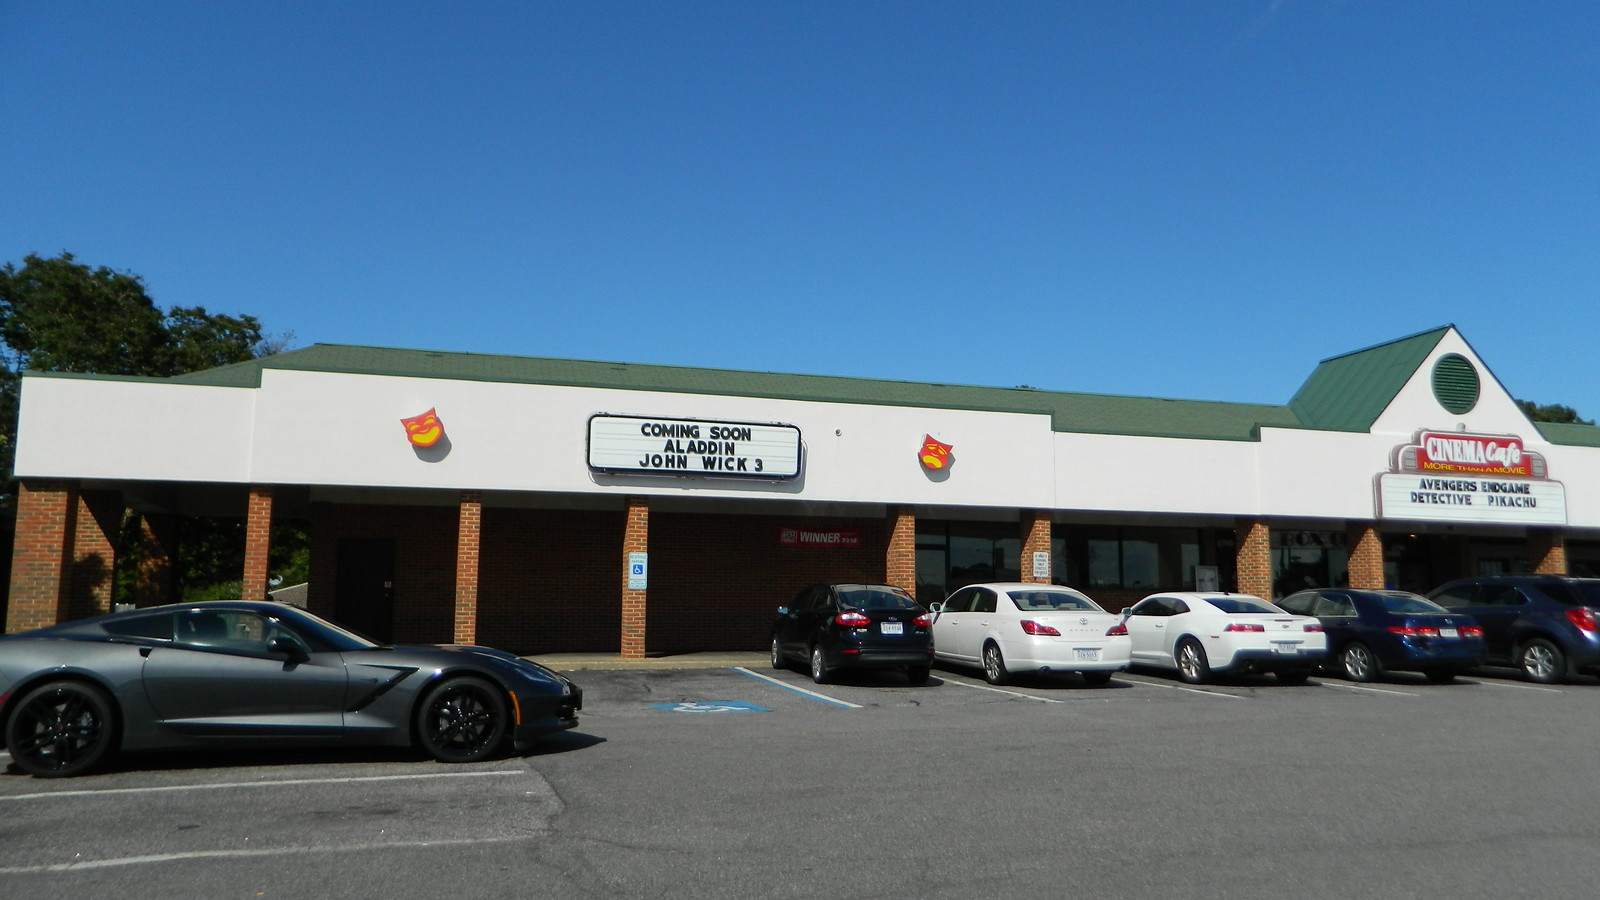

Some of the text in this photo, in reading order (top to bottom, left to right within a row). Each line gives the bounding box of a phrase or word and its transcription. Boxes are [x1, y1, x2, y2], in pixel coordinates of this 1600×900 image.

[640, 422, 751, 441] COMING SOON
[663, 439, 735, 455] ALADDIN
[1426, 437, 1487, 464] CINEMA
[639, 453, 763, 472] JOHN WICK 3
[1423, 461, 1455, 471] MORE
[1493, 466, 1526, 475] MOVIE
[1419, 478, 1530, 495] AVENGERS ENDGAME
[1410, 491, 1537, 508] DETECTIVE PIKACHU
[800, 531, 840, 543] WINNER
[1281, 532, 1324, 546] BOX
